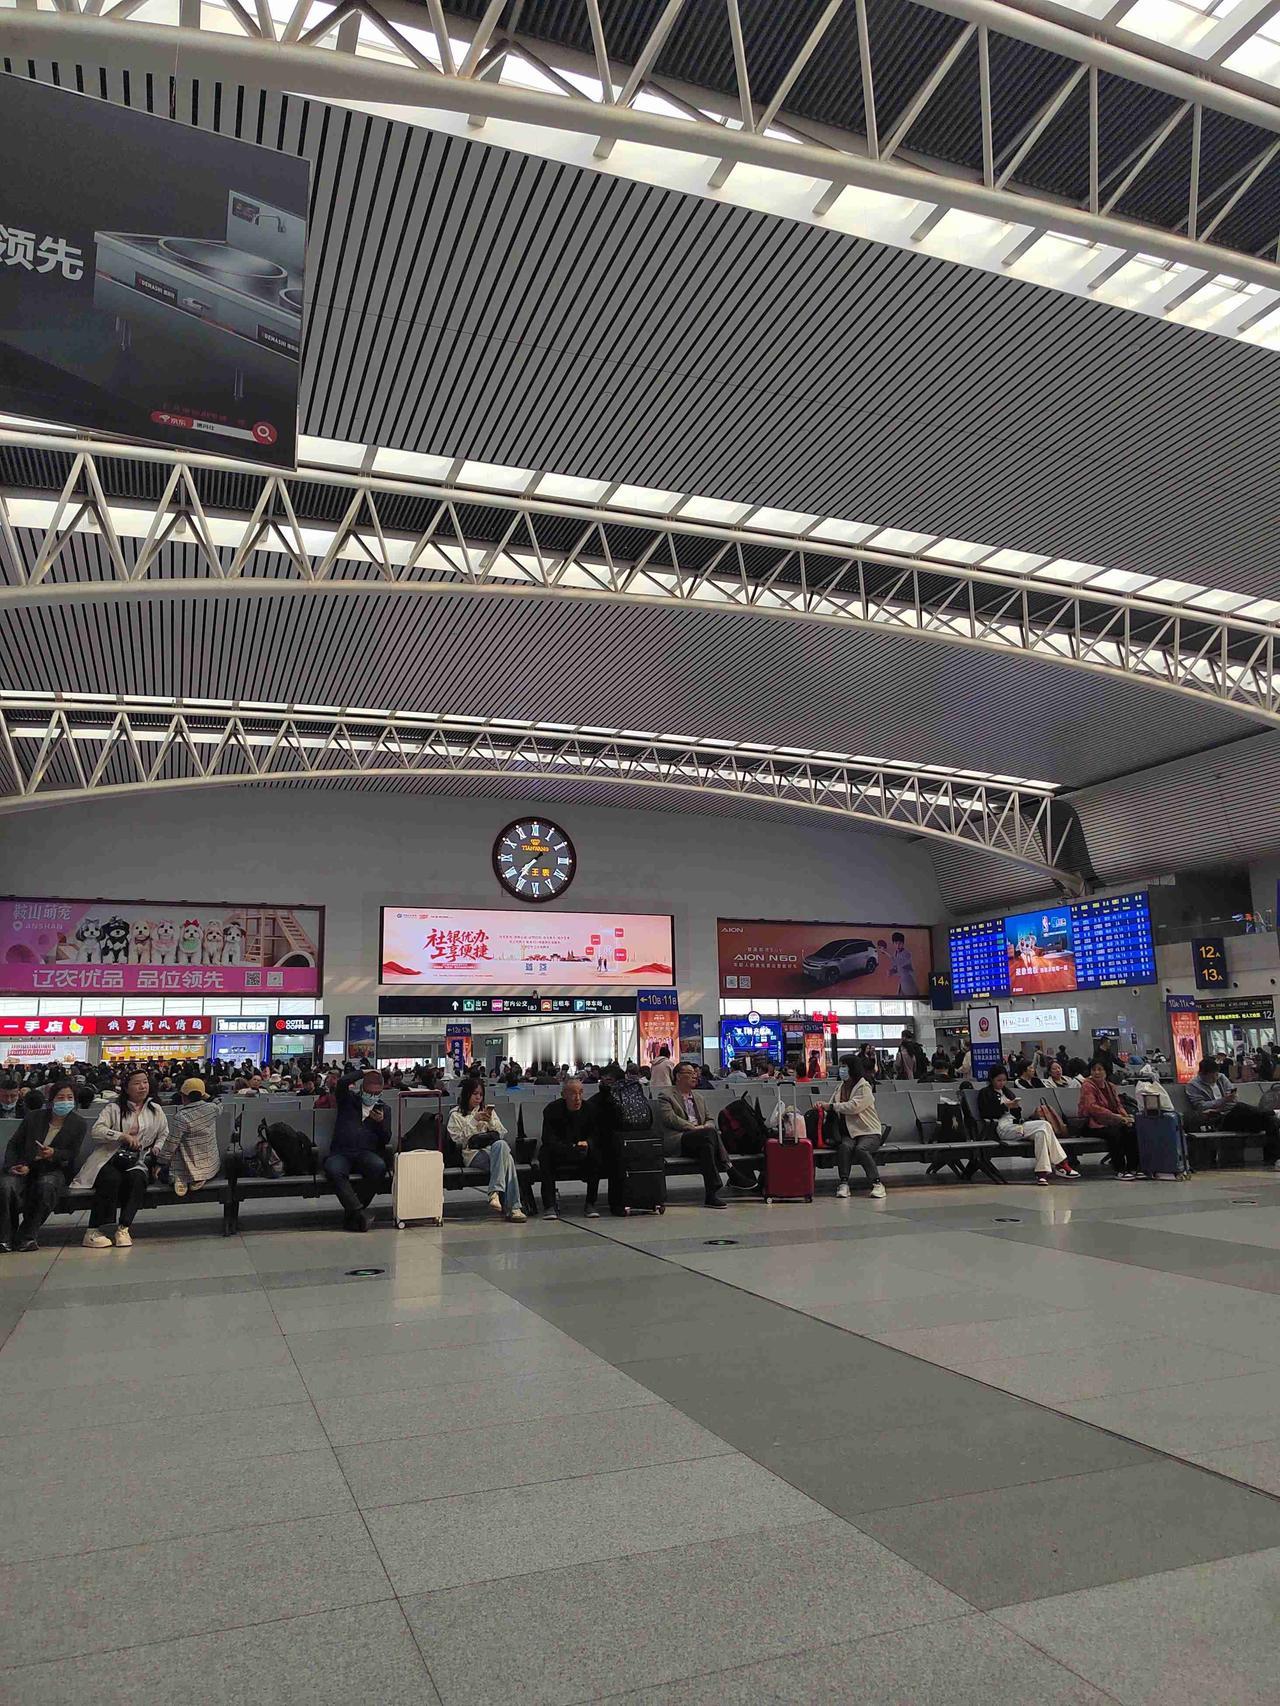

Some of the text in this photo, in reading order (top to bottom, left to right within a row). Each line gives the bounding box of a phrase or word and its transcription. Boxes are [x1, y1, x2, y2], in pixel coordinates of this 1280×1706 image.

[0, 224, 84, 280] 领先
[734, 953, 765, 961] AION
[1199, 945, 1221, 958] 12A
[32, 968, 225, 989] 辽农优品 品位领先
[932, 975, 949, 986] 14A
[1202, 968, 1224, 981] 13A
[3, 1020, 64, 1033] 一手店
